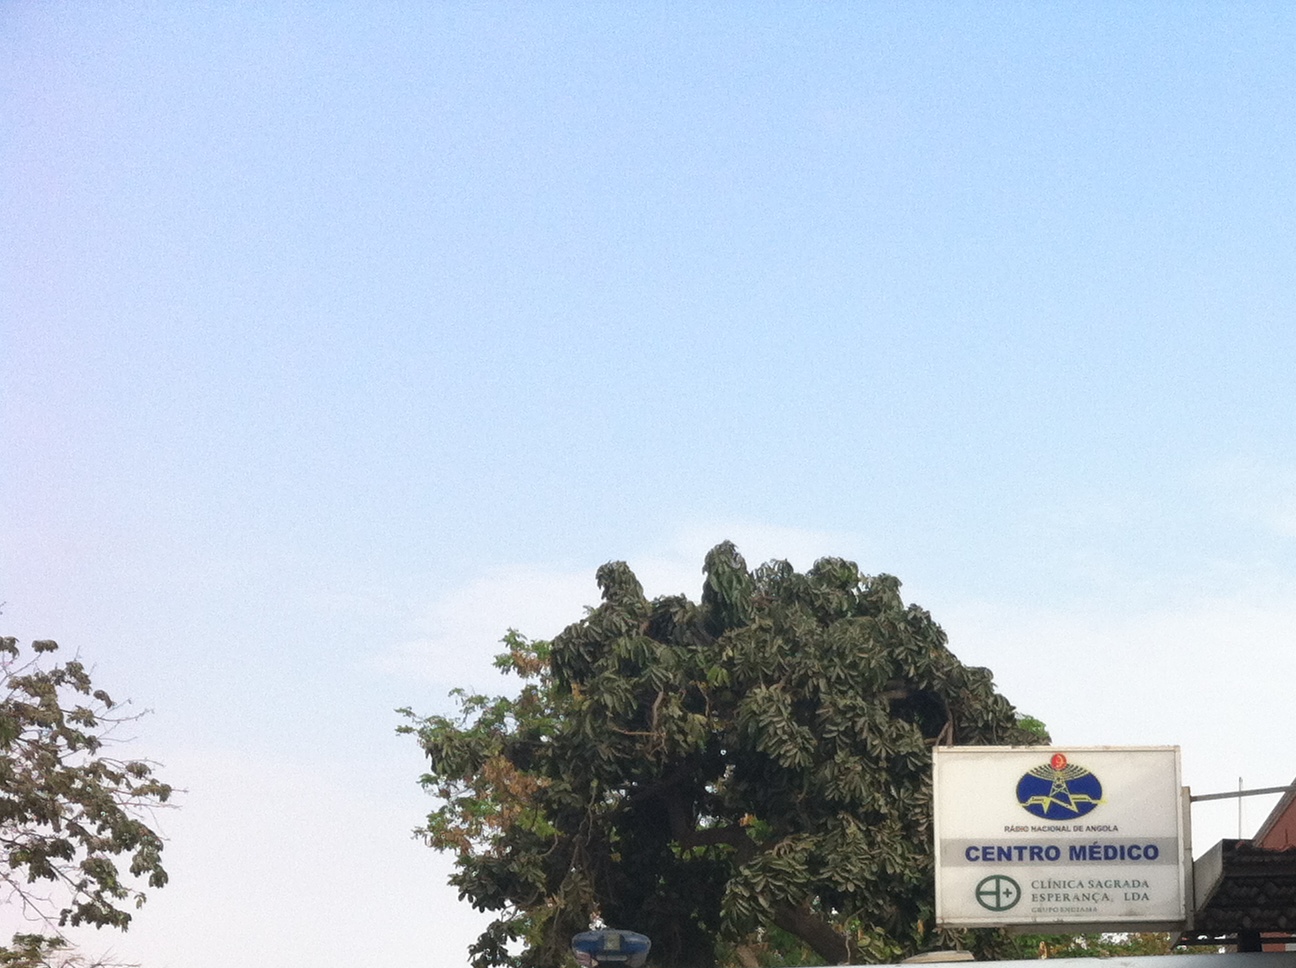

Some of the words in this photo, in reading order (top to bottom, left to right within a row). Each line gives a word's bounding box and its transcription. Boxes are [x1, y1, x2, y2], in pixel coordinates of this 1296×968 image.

[1004, 825, 1029, 833] RÁDIO
[1031, 825, 1071, 833] NACIONAL
[1073, 825, 1084, 833] DE
[1086, 825, 1118, 833] ANGOLA
[965, 845, 1060, 862] CENTRO
[1069, 841, 1159, 861] MÉDICO
[1031, 877, 1084, 889] CLÍNICA
[1088, 879, 1150, 889] SAGRADA
[1124, 891, 1150, 901] LDA
